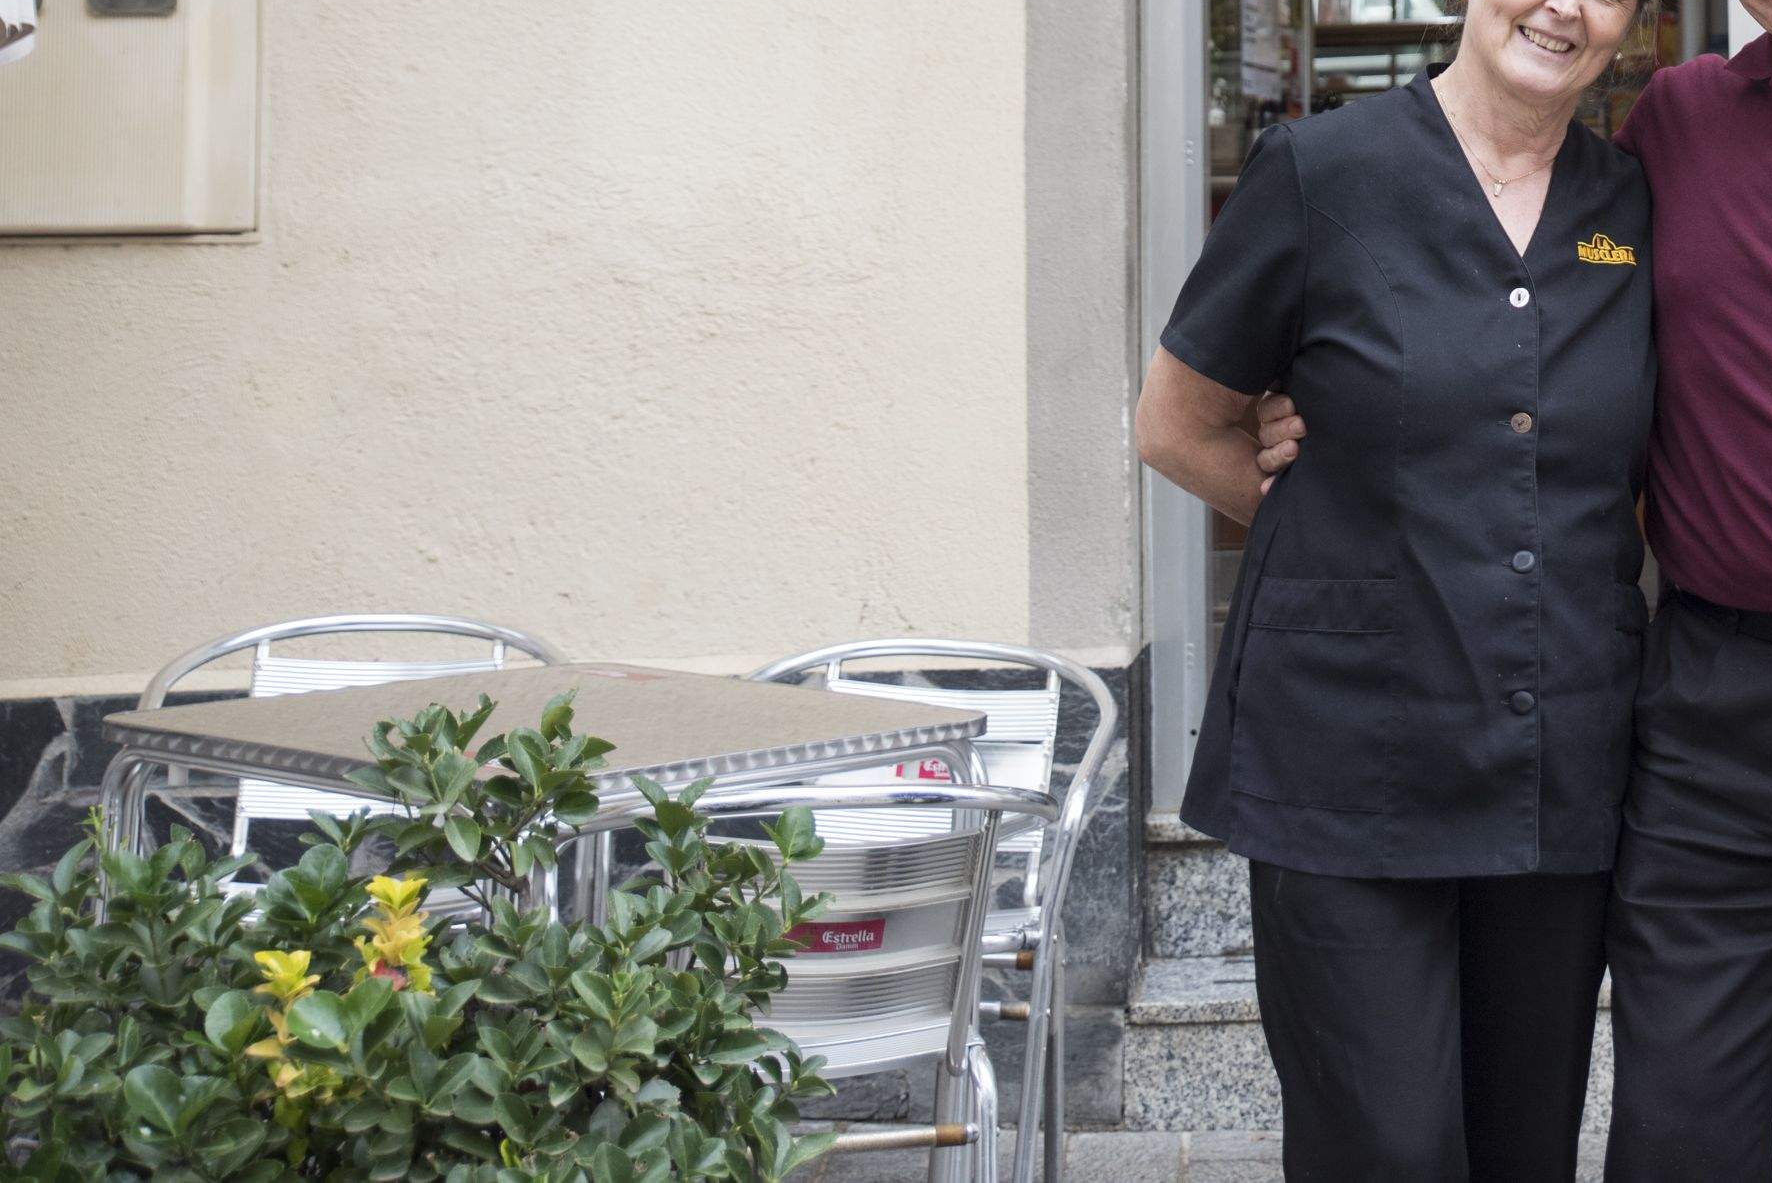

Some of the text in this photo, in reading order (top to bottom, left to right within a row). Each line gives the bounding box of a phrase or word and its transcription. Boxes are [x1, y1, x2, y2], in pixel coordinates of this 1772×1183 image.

[1596, 236, 1612, 249] LA
[1578, 245, 1636, 261] MUSCLERA
[822, 929, 875, 944] Estrella
